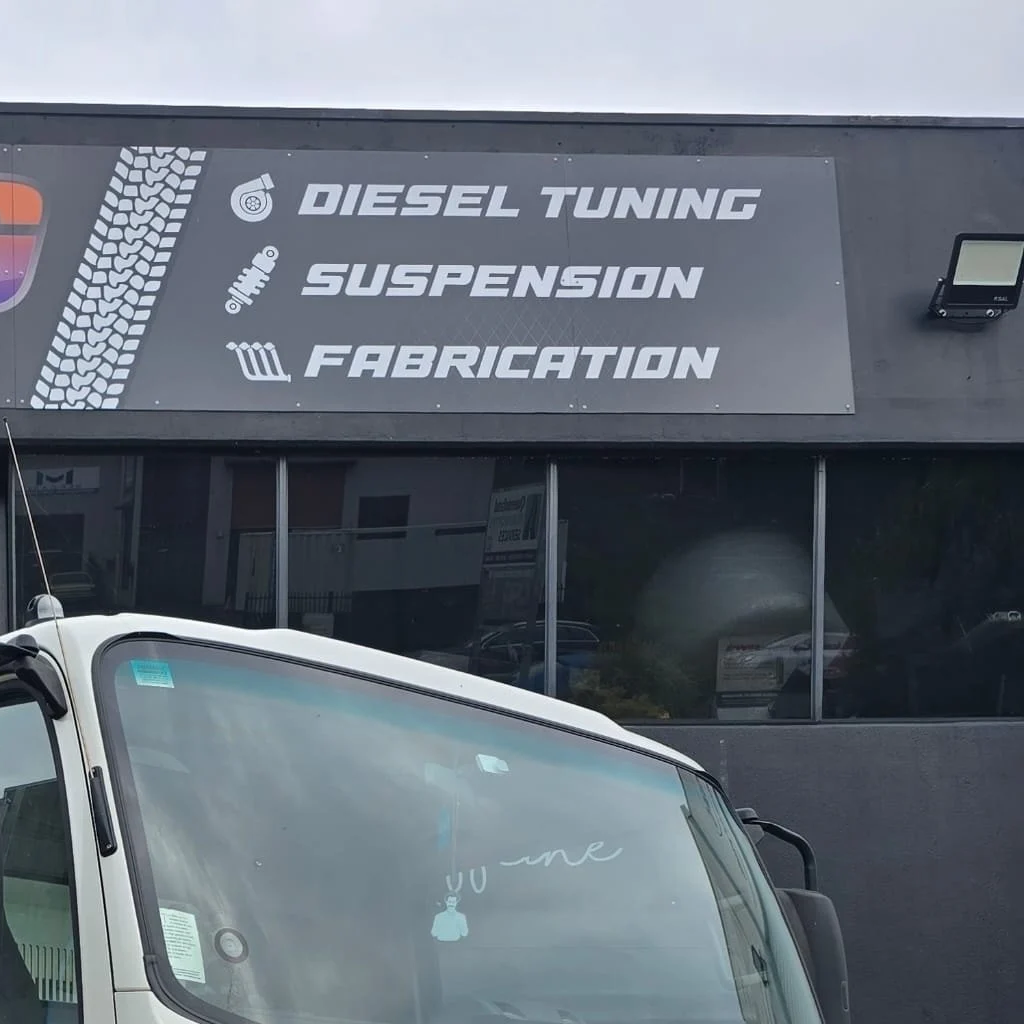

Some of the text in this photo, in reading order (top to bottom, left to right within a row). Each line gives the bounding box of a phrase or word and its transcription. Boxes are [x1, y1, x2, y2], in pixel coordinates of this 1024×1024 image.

[297, 183, 762, 220] DIESEL TUNING
[301, 263, 704, 299] SUSPENSION
[303, 344, 720, 379] FABRICATION
